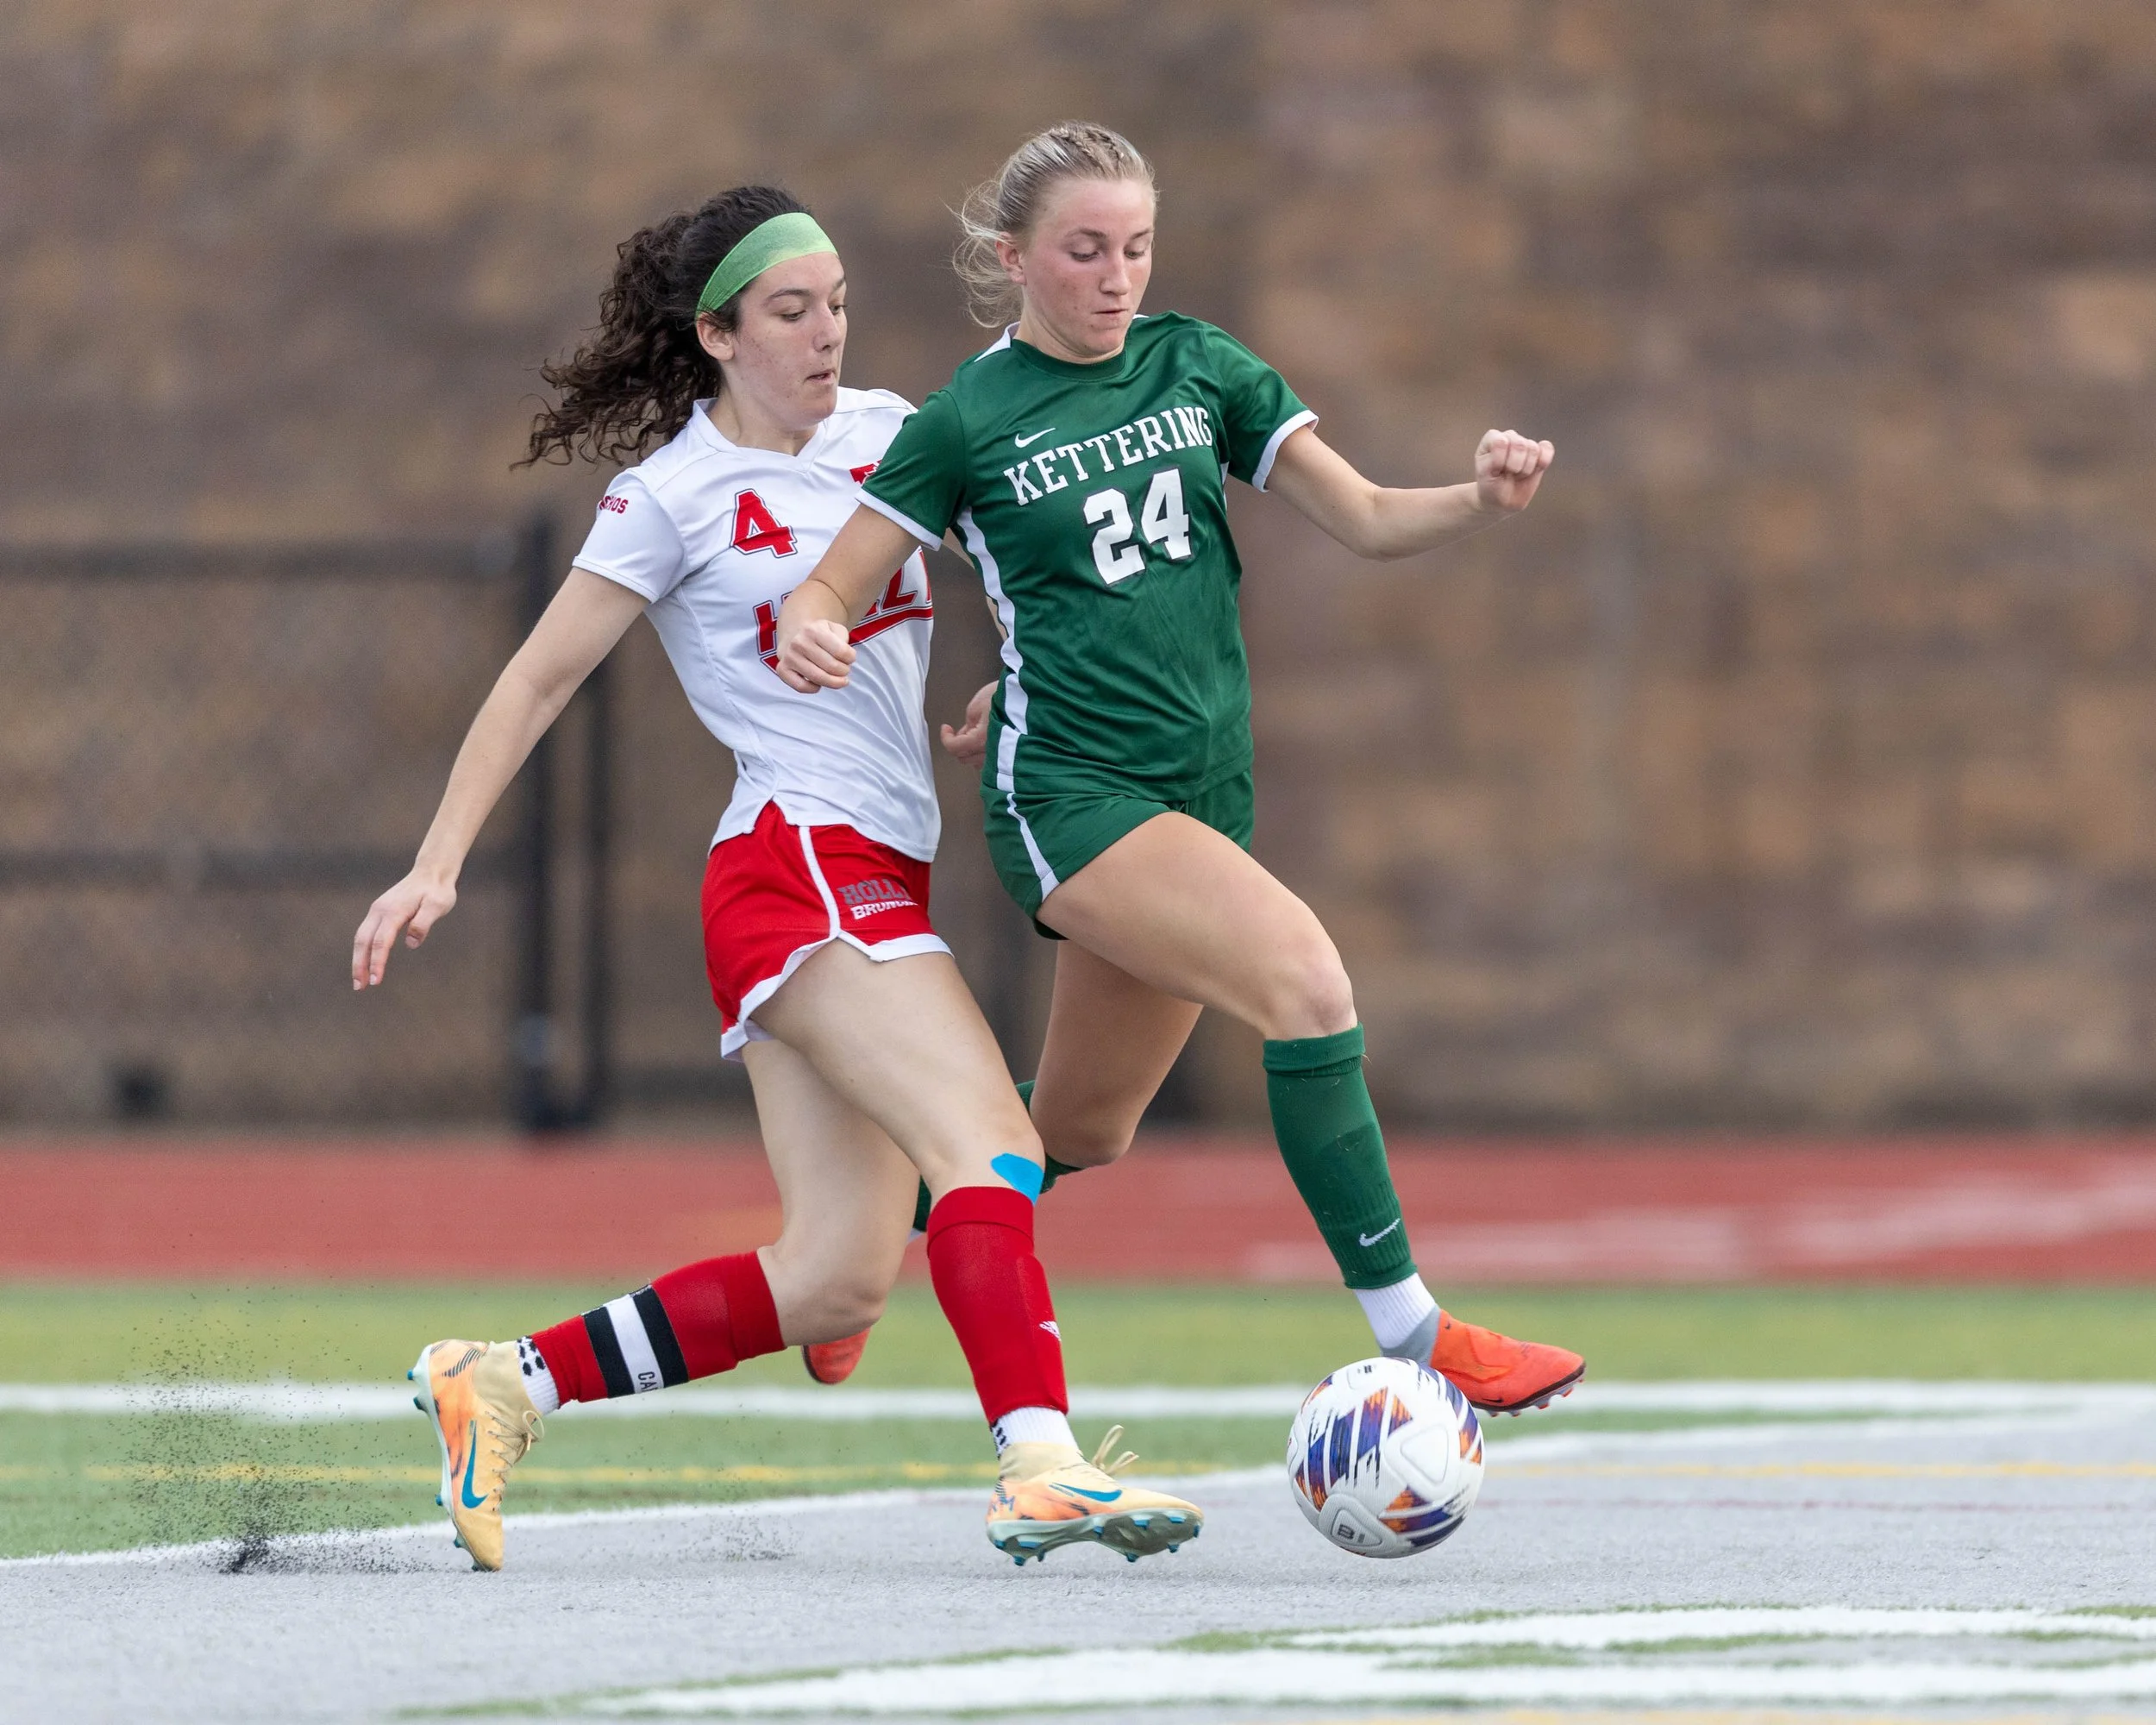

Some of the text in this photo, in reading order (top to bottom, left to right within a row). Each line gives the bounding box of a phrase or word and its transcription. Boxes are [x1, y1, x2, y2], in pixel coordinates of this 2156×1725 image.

[1003, 406, 1213, 506] KETTERING
[731, 489, 797, 557] 4
[1083, 468, 1192, 585] 24
[637, 1371, 658, 1393] CA
